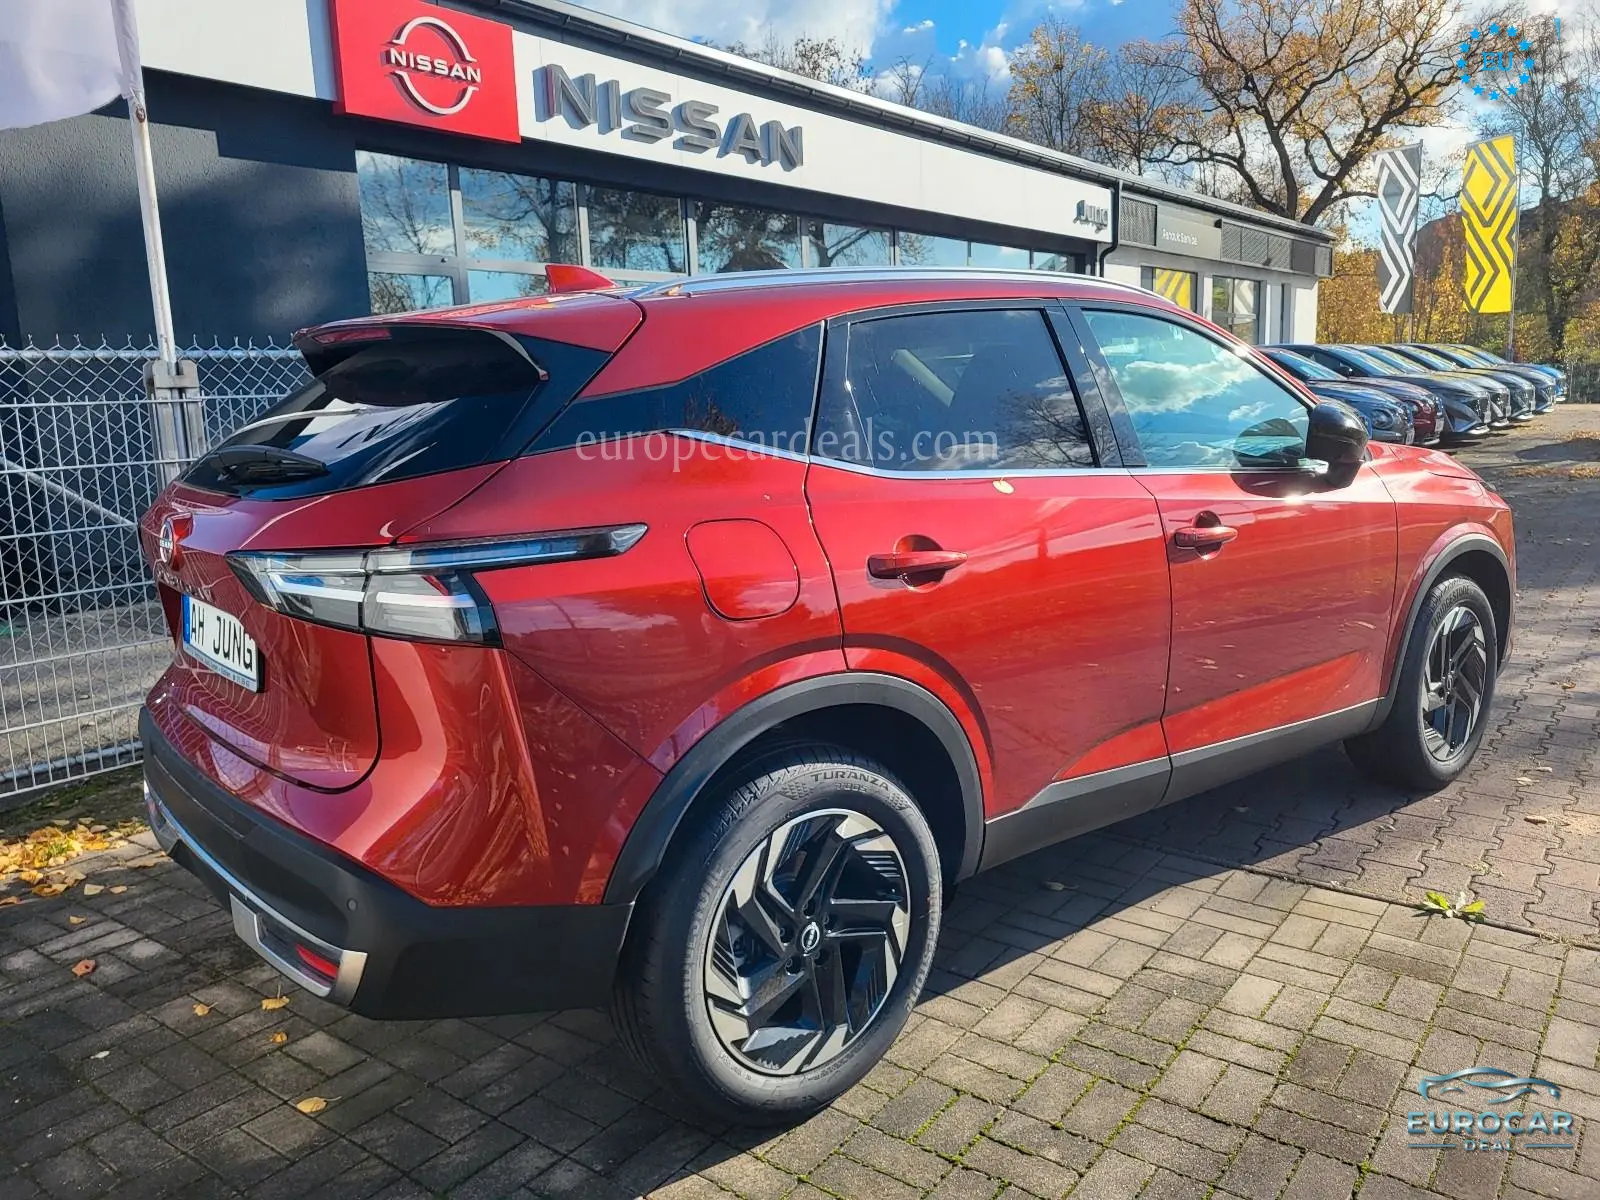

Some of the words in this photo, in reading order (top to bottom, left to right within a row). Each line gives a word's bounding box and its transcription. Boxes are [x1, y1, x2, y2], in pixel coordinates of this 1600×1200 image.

[389, 47, 481, 83] NISSAN
[546, 63, 803, 171] NISSAN
[191, 602, 205, 647] AH
[213, 615, 253, 673] JUNG
[811, 770, 889, 791] TURANZA
